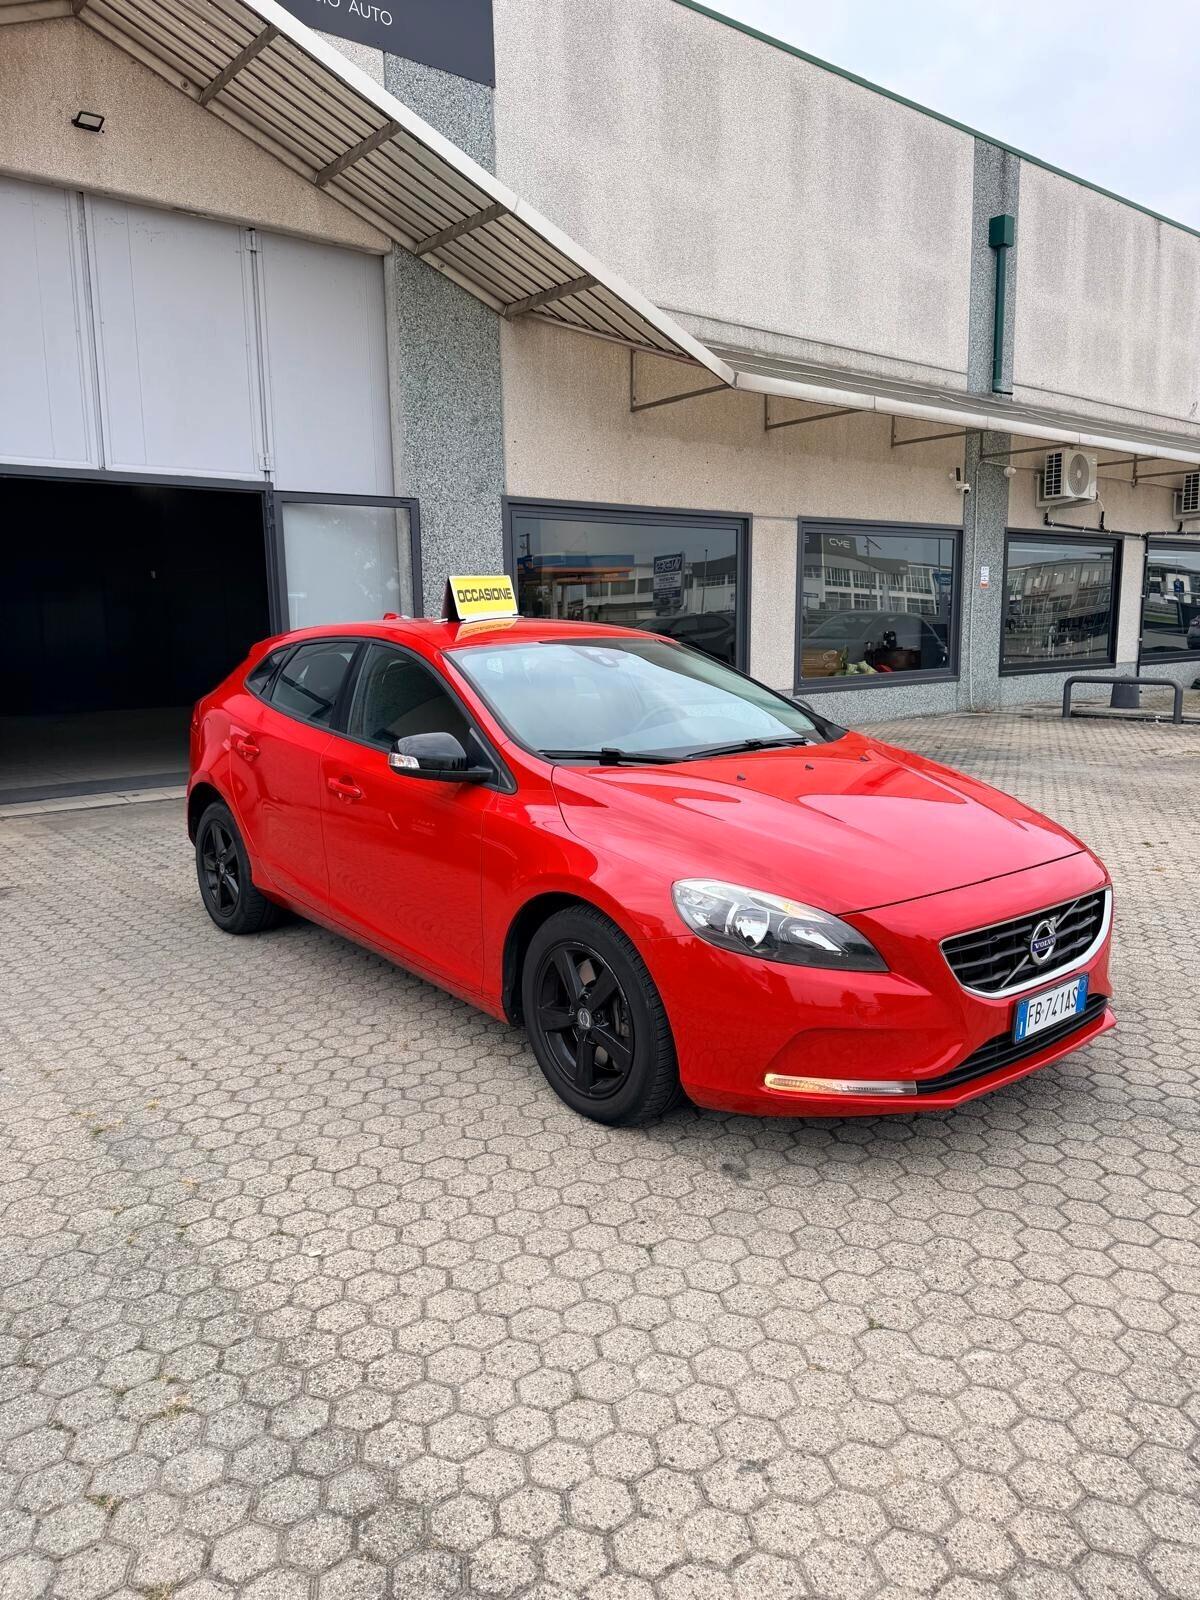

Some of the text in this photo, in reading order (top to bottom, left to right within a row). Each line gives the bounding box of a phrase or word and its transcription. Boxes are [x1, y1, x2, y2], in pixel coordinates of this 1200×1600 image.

[348, 0, 393, 26] AUTO
[456, 587, 513, 603] OCCASIONE
[1033, 936, 1056, 949] VOLVO
